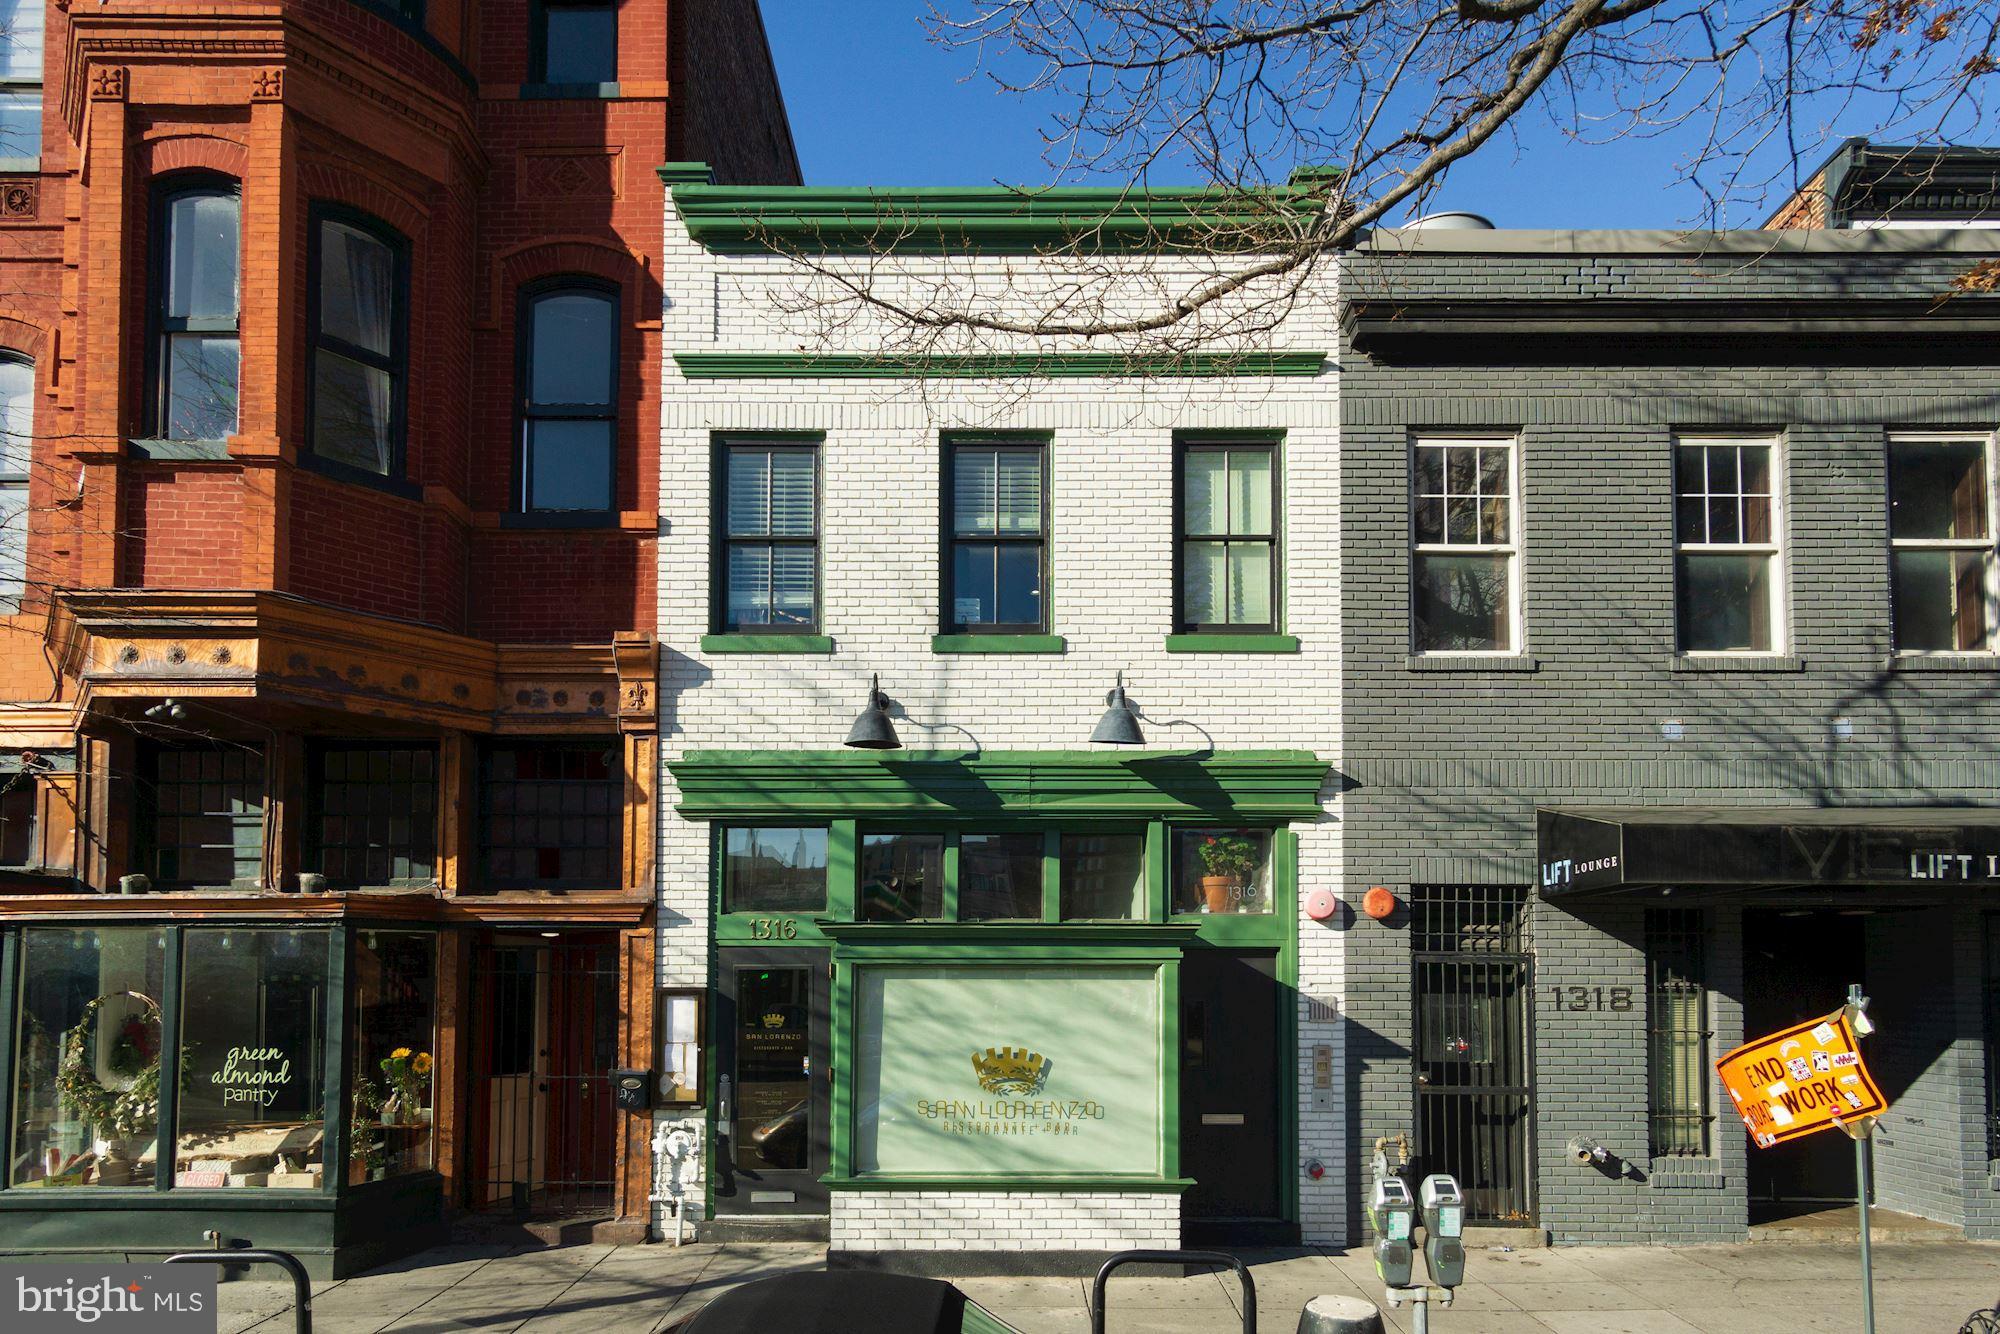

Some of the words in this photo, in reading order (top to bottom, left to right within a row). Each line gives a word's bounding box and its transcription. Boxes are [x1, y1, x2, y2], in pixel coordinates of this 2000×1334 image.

[1543, 860, 1571, 886] LIFT
[1575, 856, 1618, 874] LOUNGE
[1911, 854, 1973, 880] LIFT
[1228, 883, 1257, 901] 1316
[749, 919, 797, 940] 1316
[1552, 986, 1632, 1011] 1318
[227, 1046, 283, 1070] green
[211, 1059, 291, 1085] almond
[1744, 1057, 1785, 1089] END
[223, 1087, 278, 1107] pantry
[918, 1100, 966, 1116] SAN
[980, 1100, 1098, 1116] LORENZO
[1778, 1077, 1846, 1115] WORK
[187, 1173, 220, 1186] CLOSED
